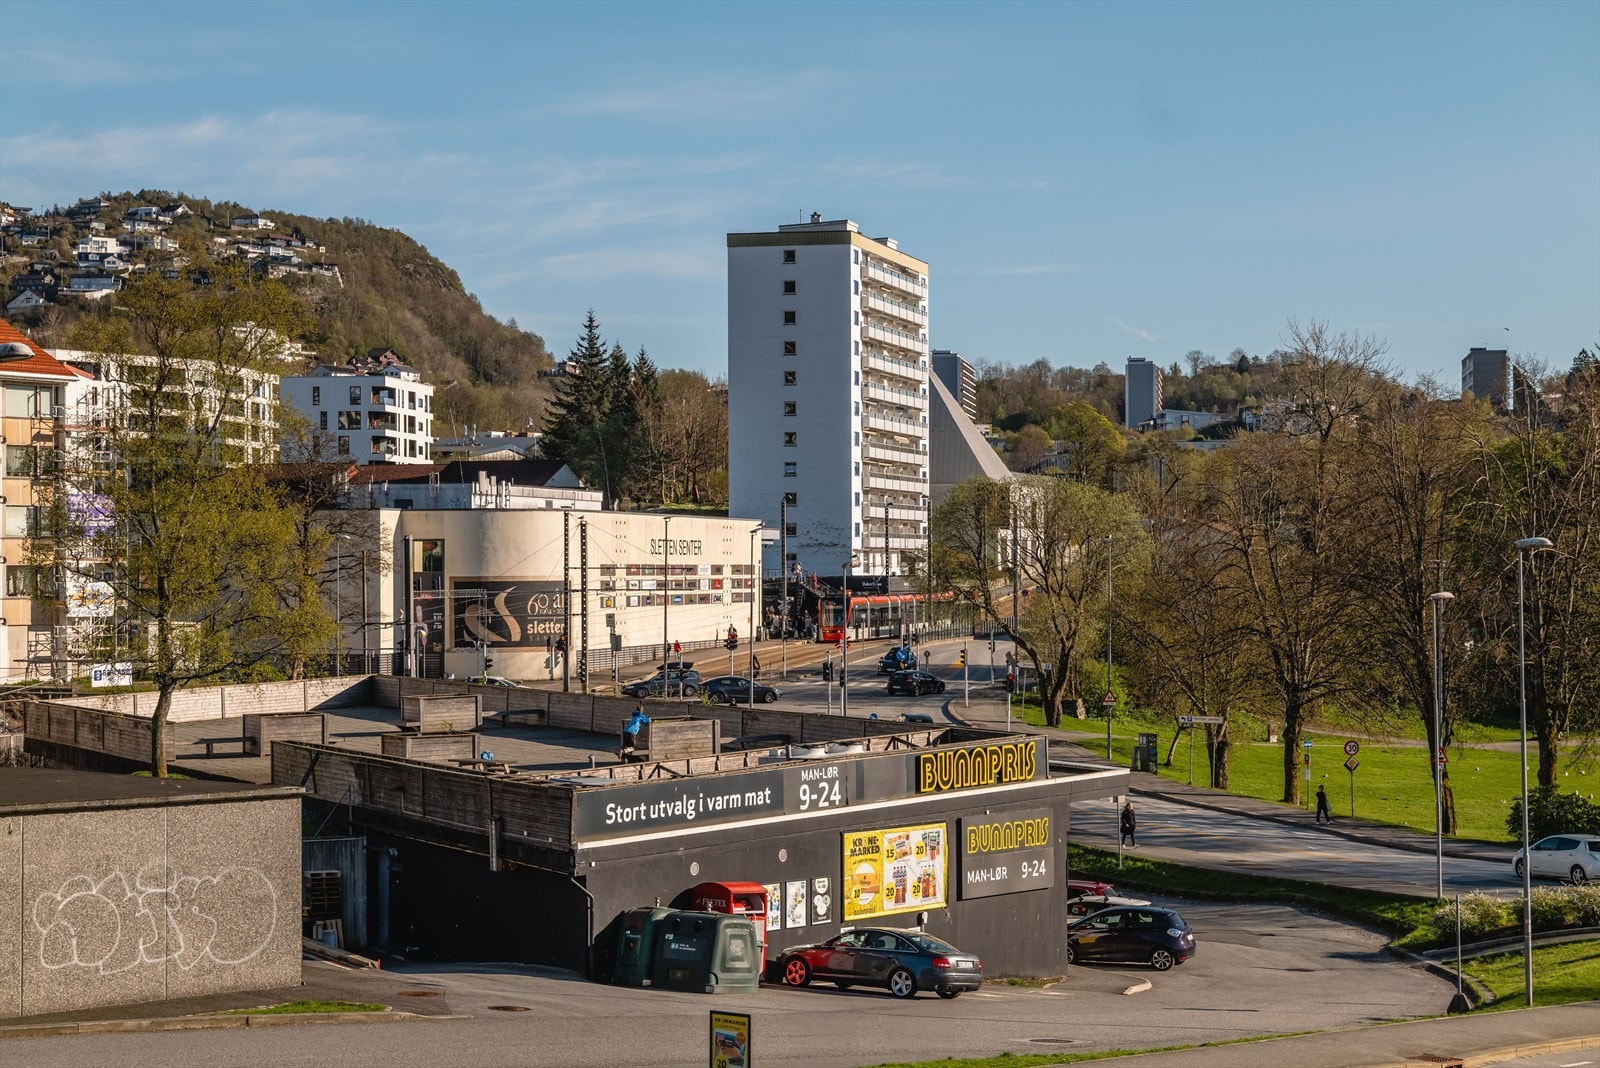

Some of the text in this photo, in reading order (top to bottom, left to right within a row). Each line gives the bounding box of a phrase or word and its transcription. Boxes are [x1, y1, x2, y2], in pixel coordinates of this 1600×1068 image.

[678, 539, 703, 556] SENTER
[527, 593, 549, 616] 60
[1347, 744, 1357, 752] 30
[920, 741, 1036, 793] BUNNPRIS
[801, 767, 839, 782] MAN-LØR
[799, 780, 842, 811] 9-24
[605, 786, 772, 825] Stort utvalg i varm mat
[967, 817, 1049, 853] BUNNPRIS
[850, 845, 880, 858] MARKED
[886, 849, 895, 859] 15
[915, 845, 924, 855] 20
[967, 859, 1047, 884] MAN-LØR 9-24
[854, 888, 861, 899] 10
[886, 887, 895, 897] 20
[912, 884, 921, 894] 20
[716, 1058, 727, 1068] 20
